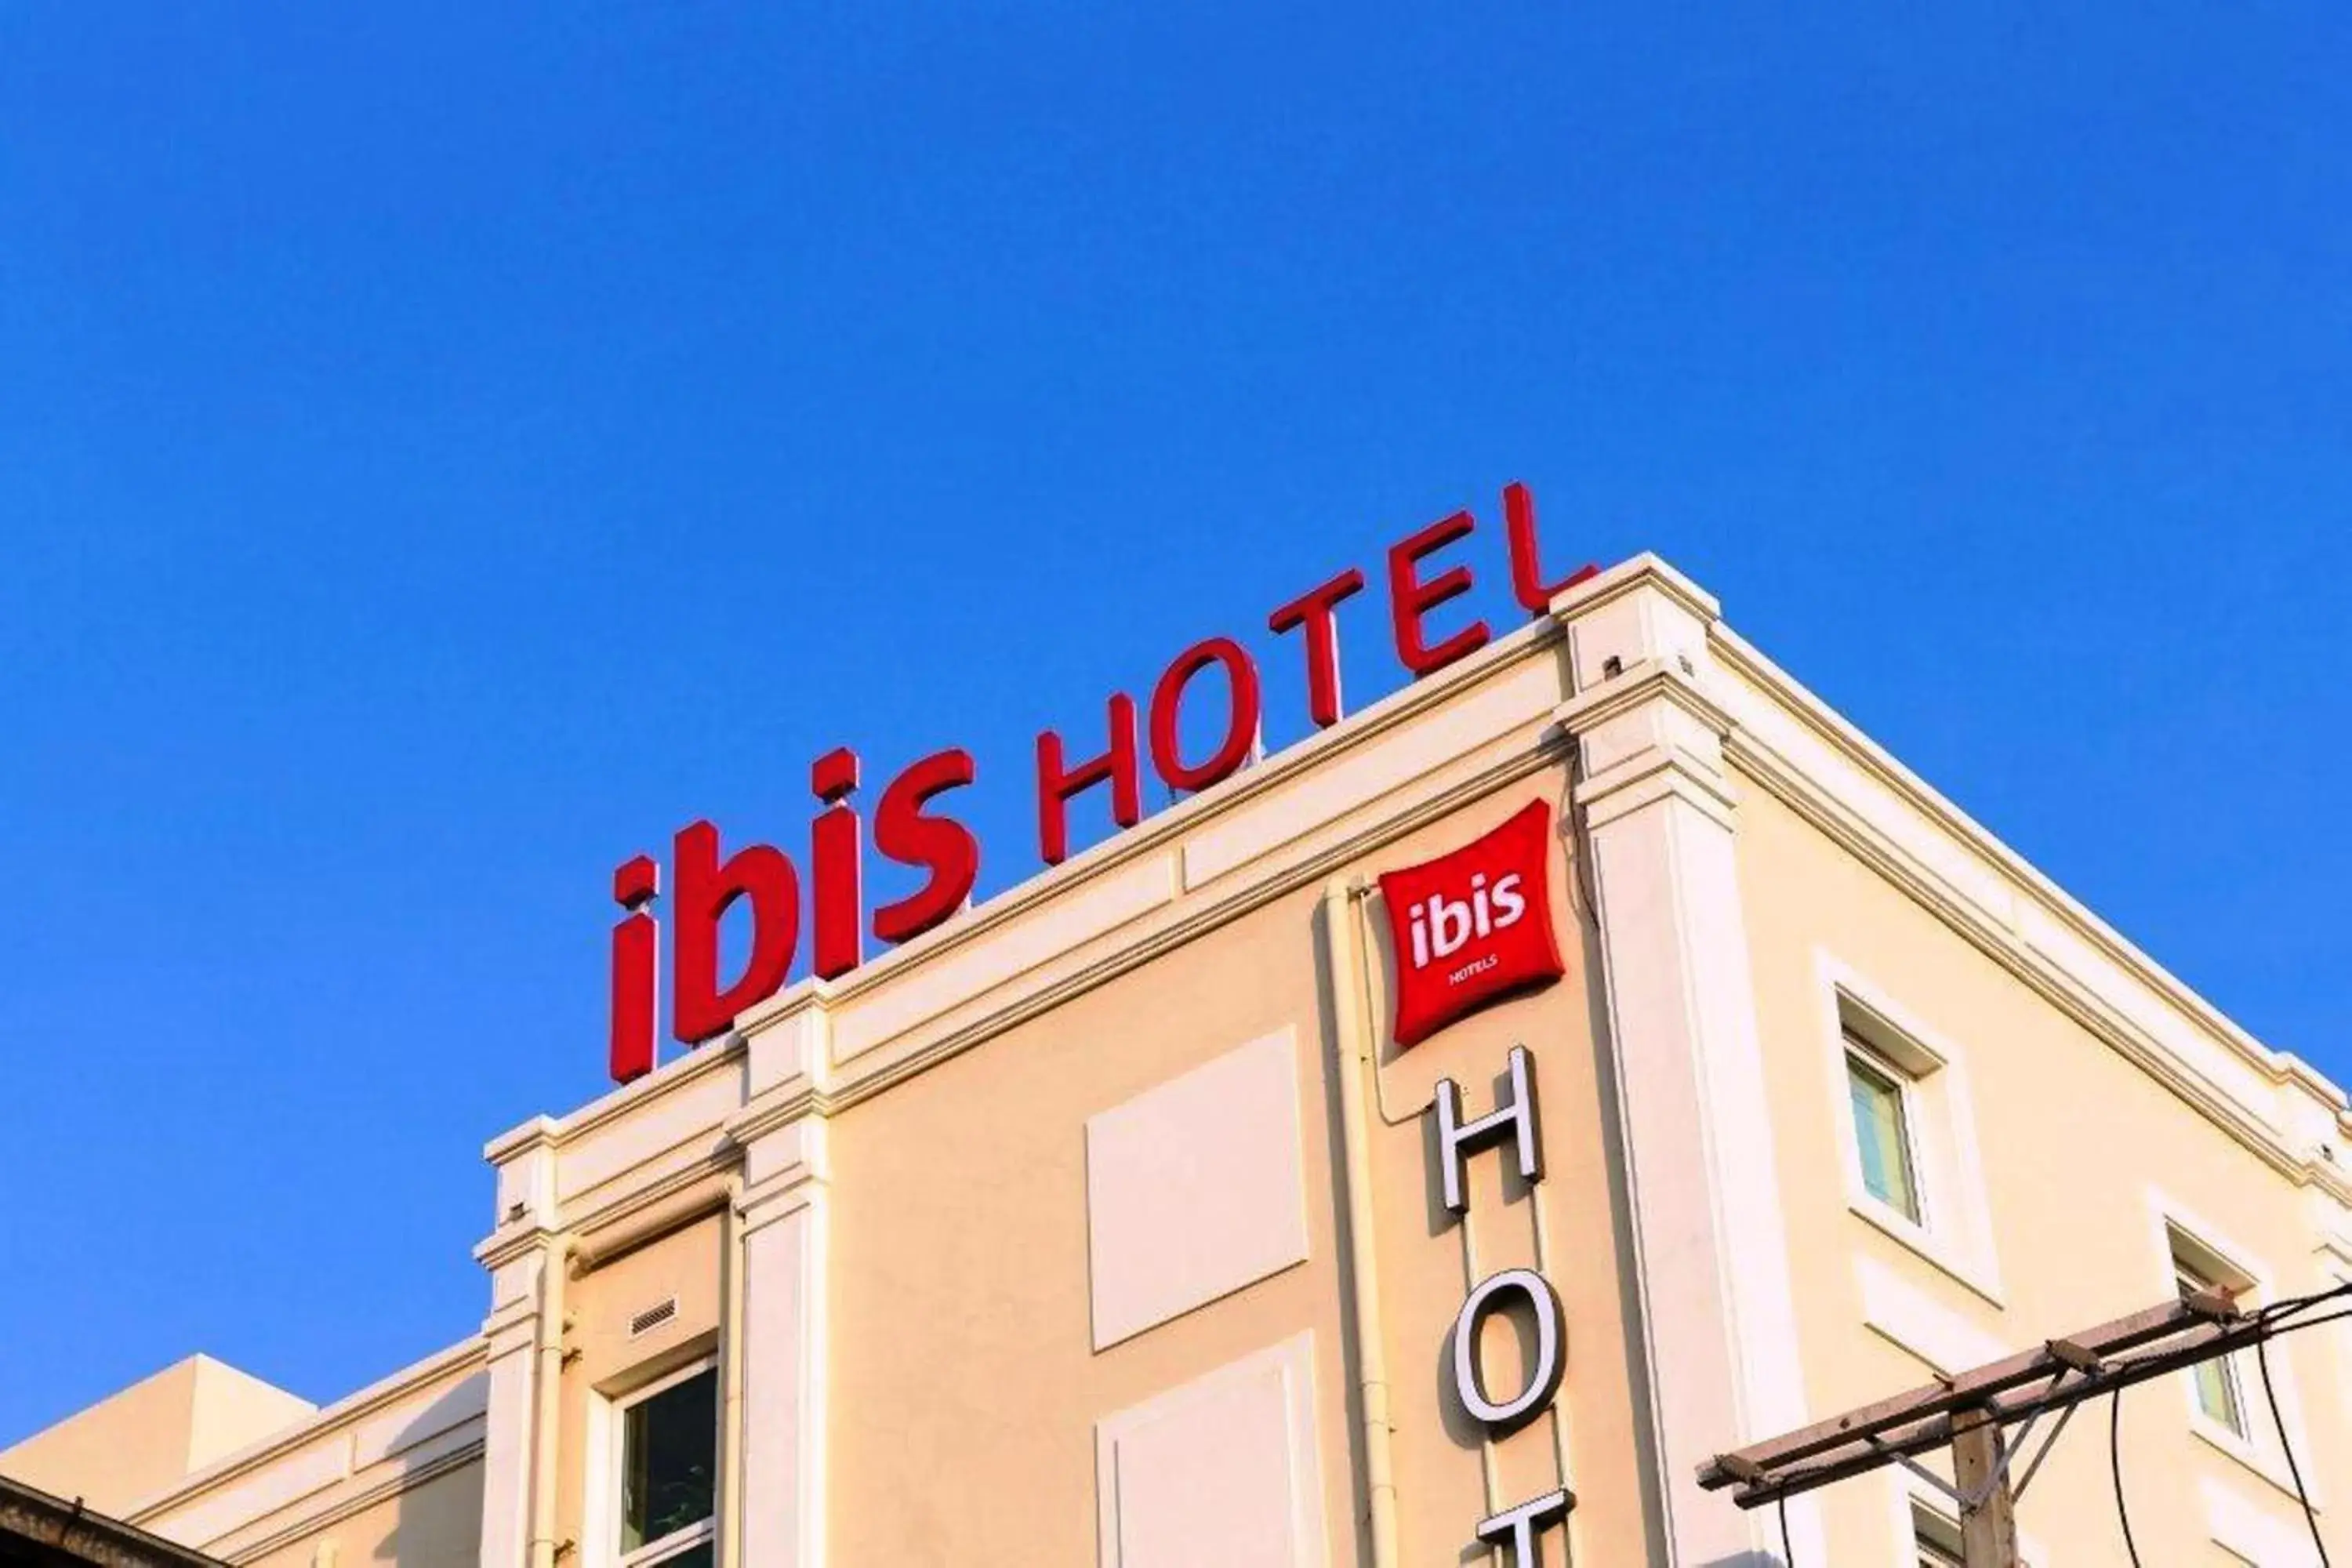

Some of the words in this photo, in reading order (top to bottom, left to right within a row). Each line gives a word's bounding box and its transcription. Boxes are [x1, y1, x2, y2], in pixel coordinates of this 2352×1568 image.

[610, 746, 979, 1084] ibis
[1035, 480, 1599, 867] HOTEL
[1408, 872, 1526, 969] ibis
[1448, 953, 1499, 986] HOTELS
